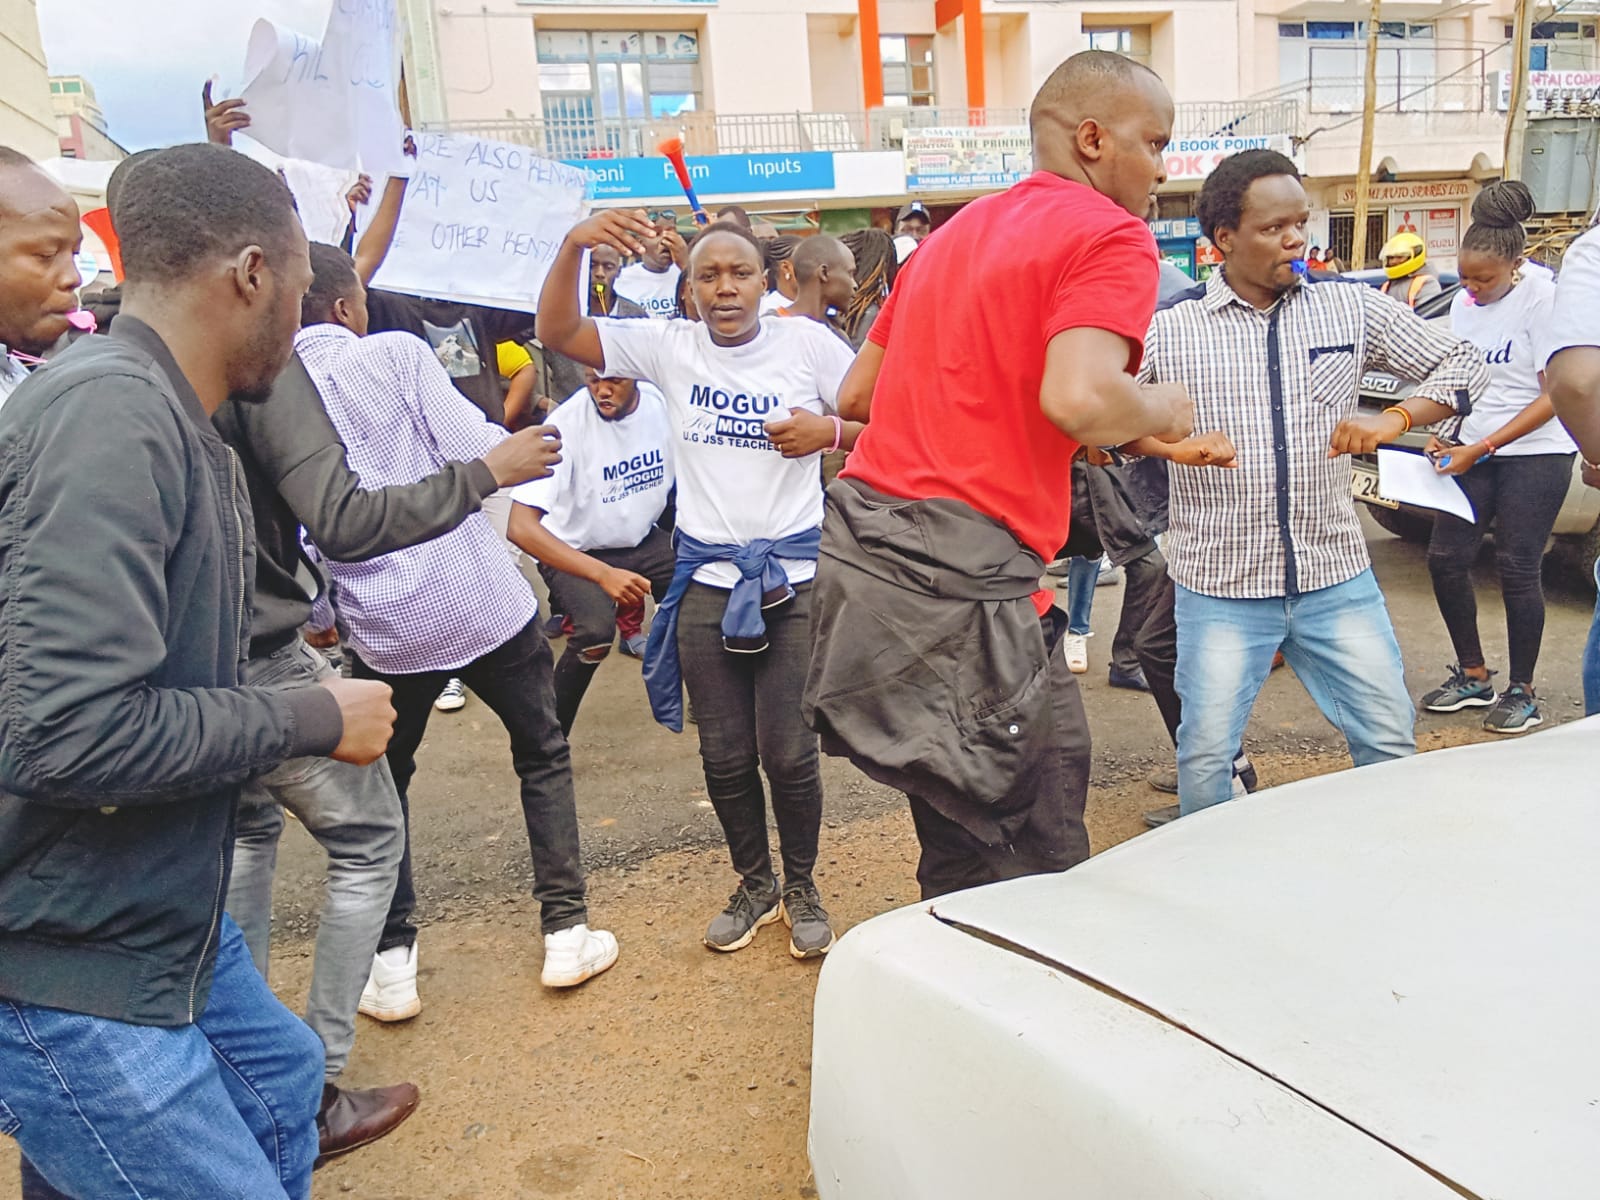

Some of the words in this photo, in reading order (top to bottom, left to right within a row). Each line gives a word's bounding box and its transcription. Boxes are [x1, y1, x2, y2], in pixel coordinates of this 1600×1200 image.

[465, 142, 521, 169] ALSO
[1180, 140, 1219, 151] BOOK
[1225, 138, 1267, 149] POINT
[748, 158, 802, 178] Inputs
[470, 179, 502, 203] US
[432, 223, 489, 250] OTHER
[1360, 376, 1400, 393] SUZU
[689, 384, 779, 415] MOGU
[703, 435, 724, 446] JSS
[603, 449, 663, 481] MOGUL
